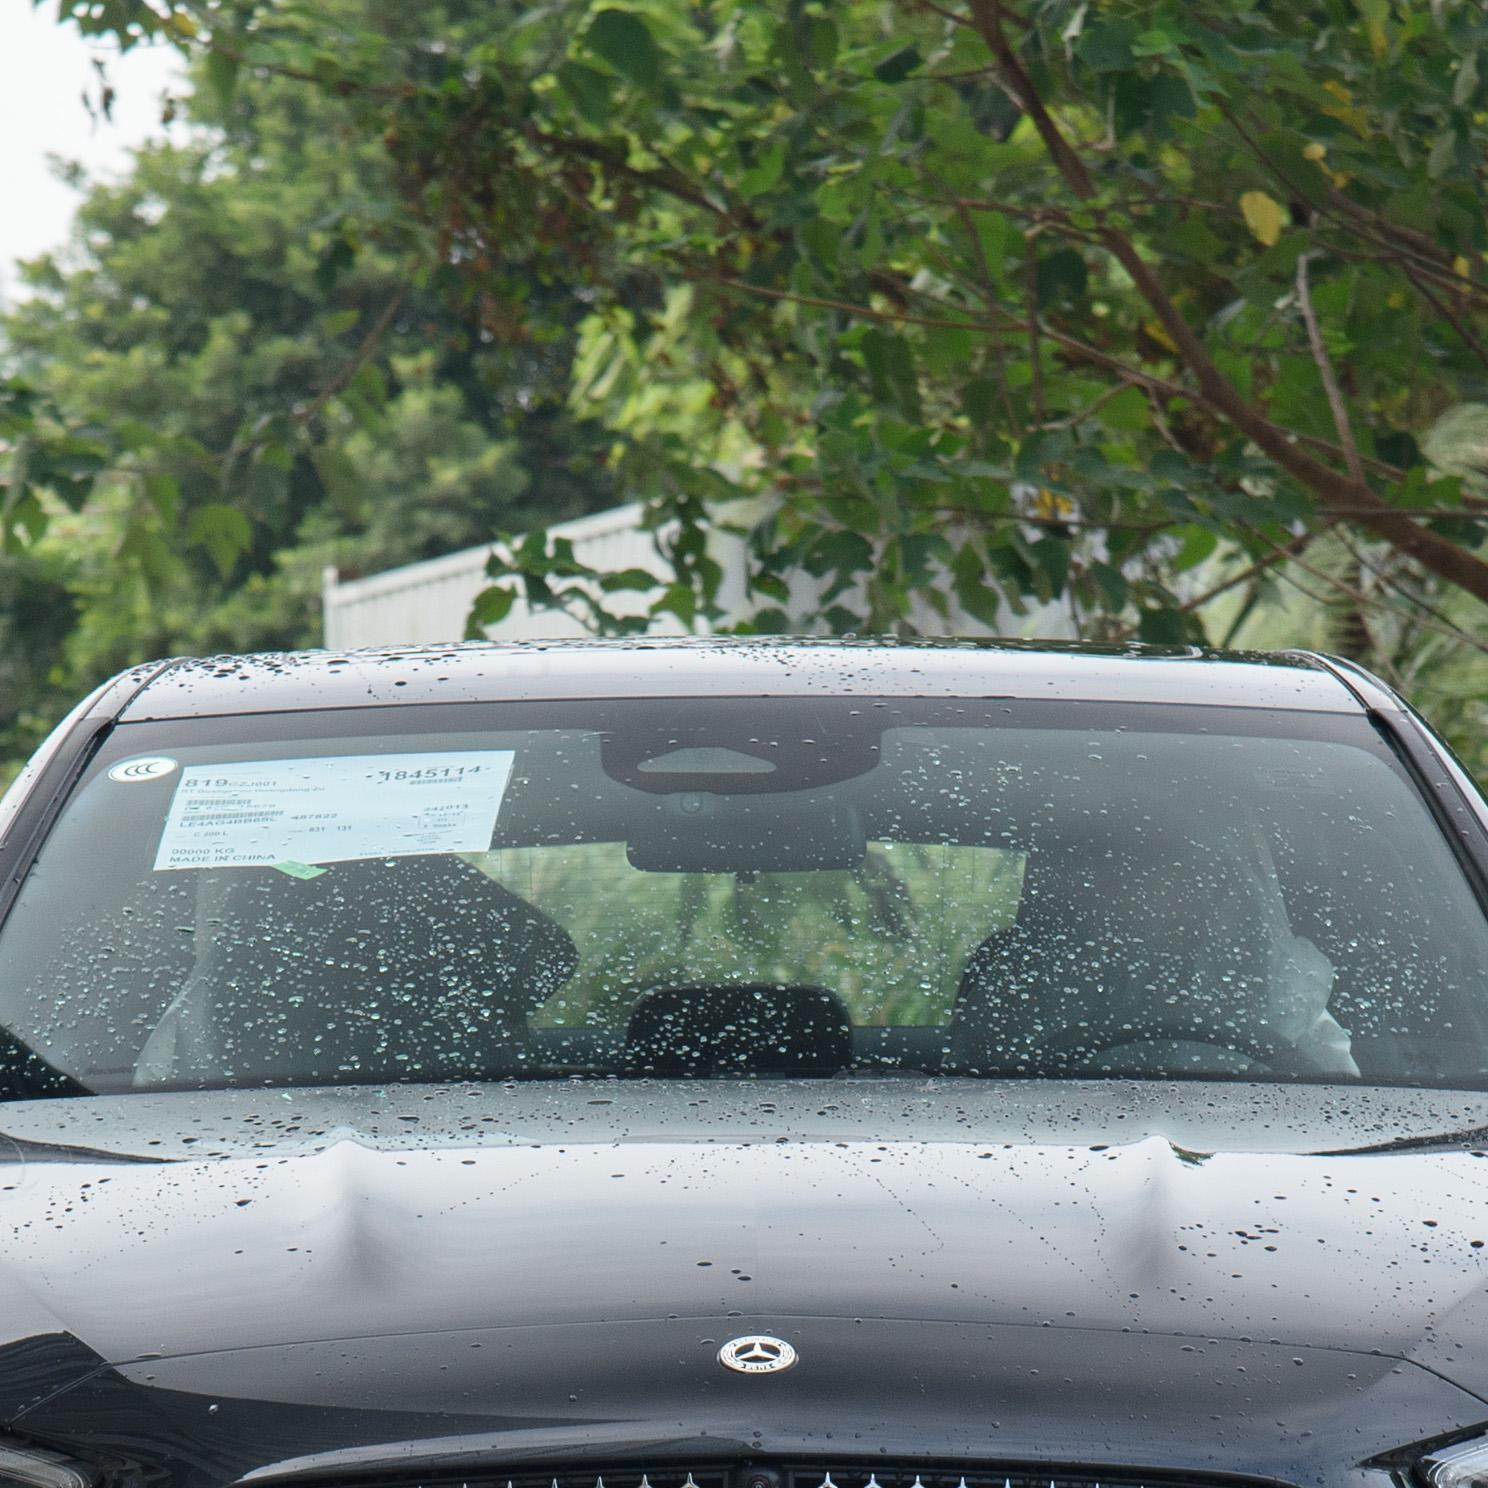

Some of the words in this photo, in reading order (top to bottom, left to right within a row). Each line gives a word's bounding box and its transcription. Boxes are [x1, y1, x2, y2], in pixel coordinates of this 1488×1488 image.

[169, 855, 210, 863] MADE
[214, 854, 229, 863] IN
[232, 853, 277, 862] CHINA
